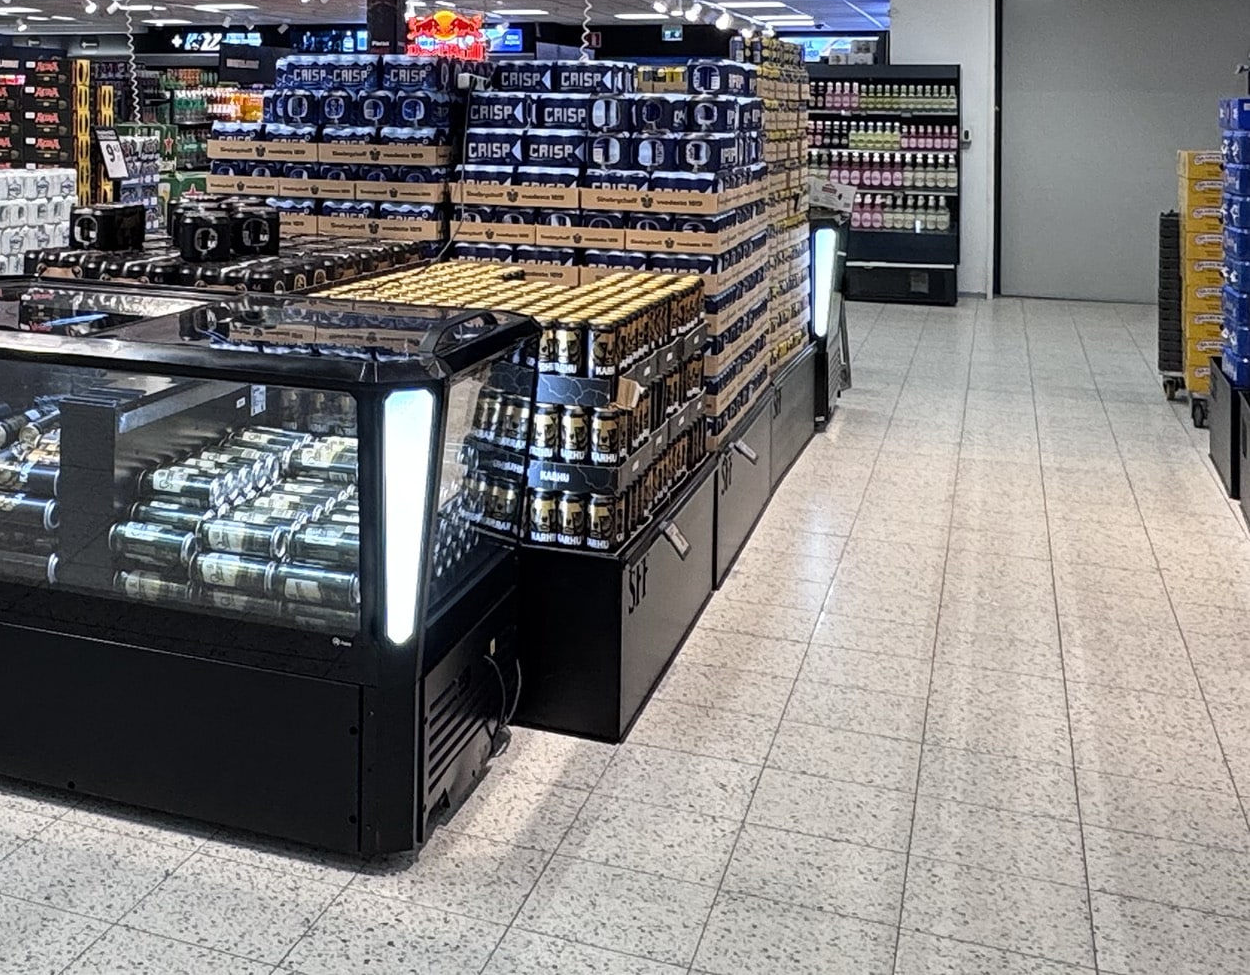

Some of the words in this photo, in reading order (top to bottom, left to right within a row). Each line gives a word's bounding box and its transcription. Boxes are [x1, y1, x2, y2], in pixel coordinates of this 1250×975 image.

[390, 69, 426, 82] CRISP
[501, 72, 541, 86] CRISP
[561, 72, 600, 86] CRISP
[470, 102, 513, 120] CRISP
[544, 107, 587, 123] CRISP
[468, 141, 511, 158] CRISP
[529, 144, 574, 160] CRISP
[540, 470, 570, 483] KARHU
